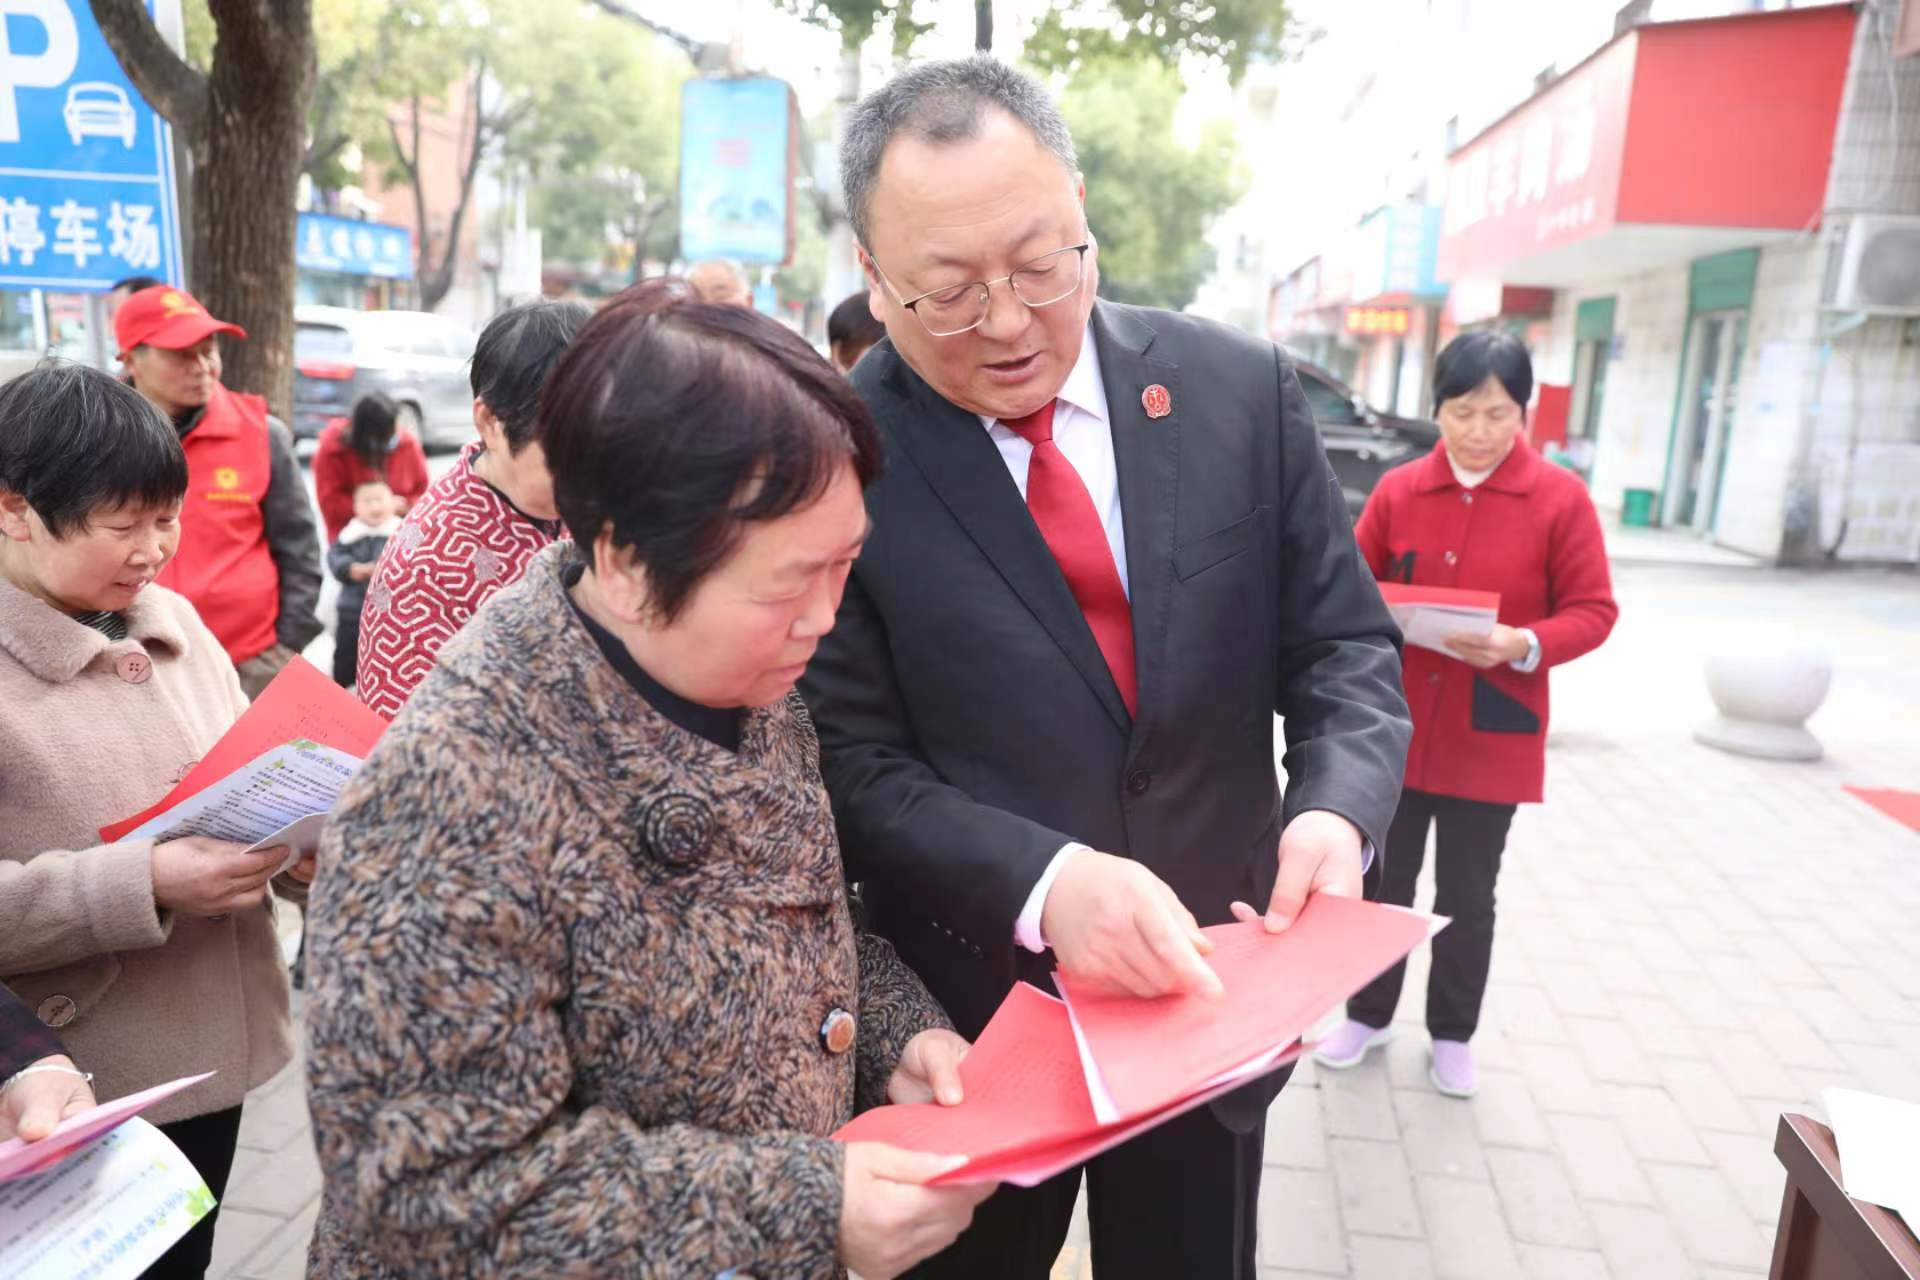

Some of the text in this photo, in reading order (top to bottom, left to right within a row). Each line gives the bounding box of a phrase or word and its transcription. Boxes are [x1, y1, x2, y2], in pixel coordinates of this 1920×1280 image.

[0, 0, 79, 142] P
[0, 195, 161, 269] 停车场
